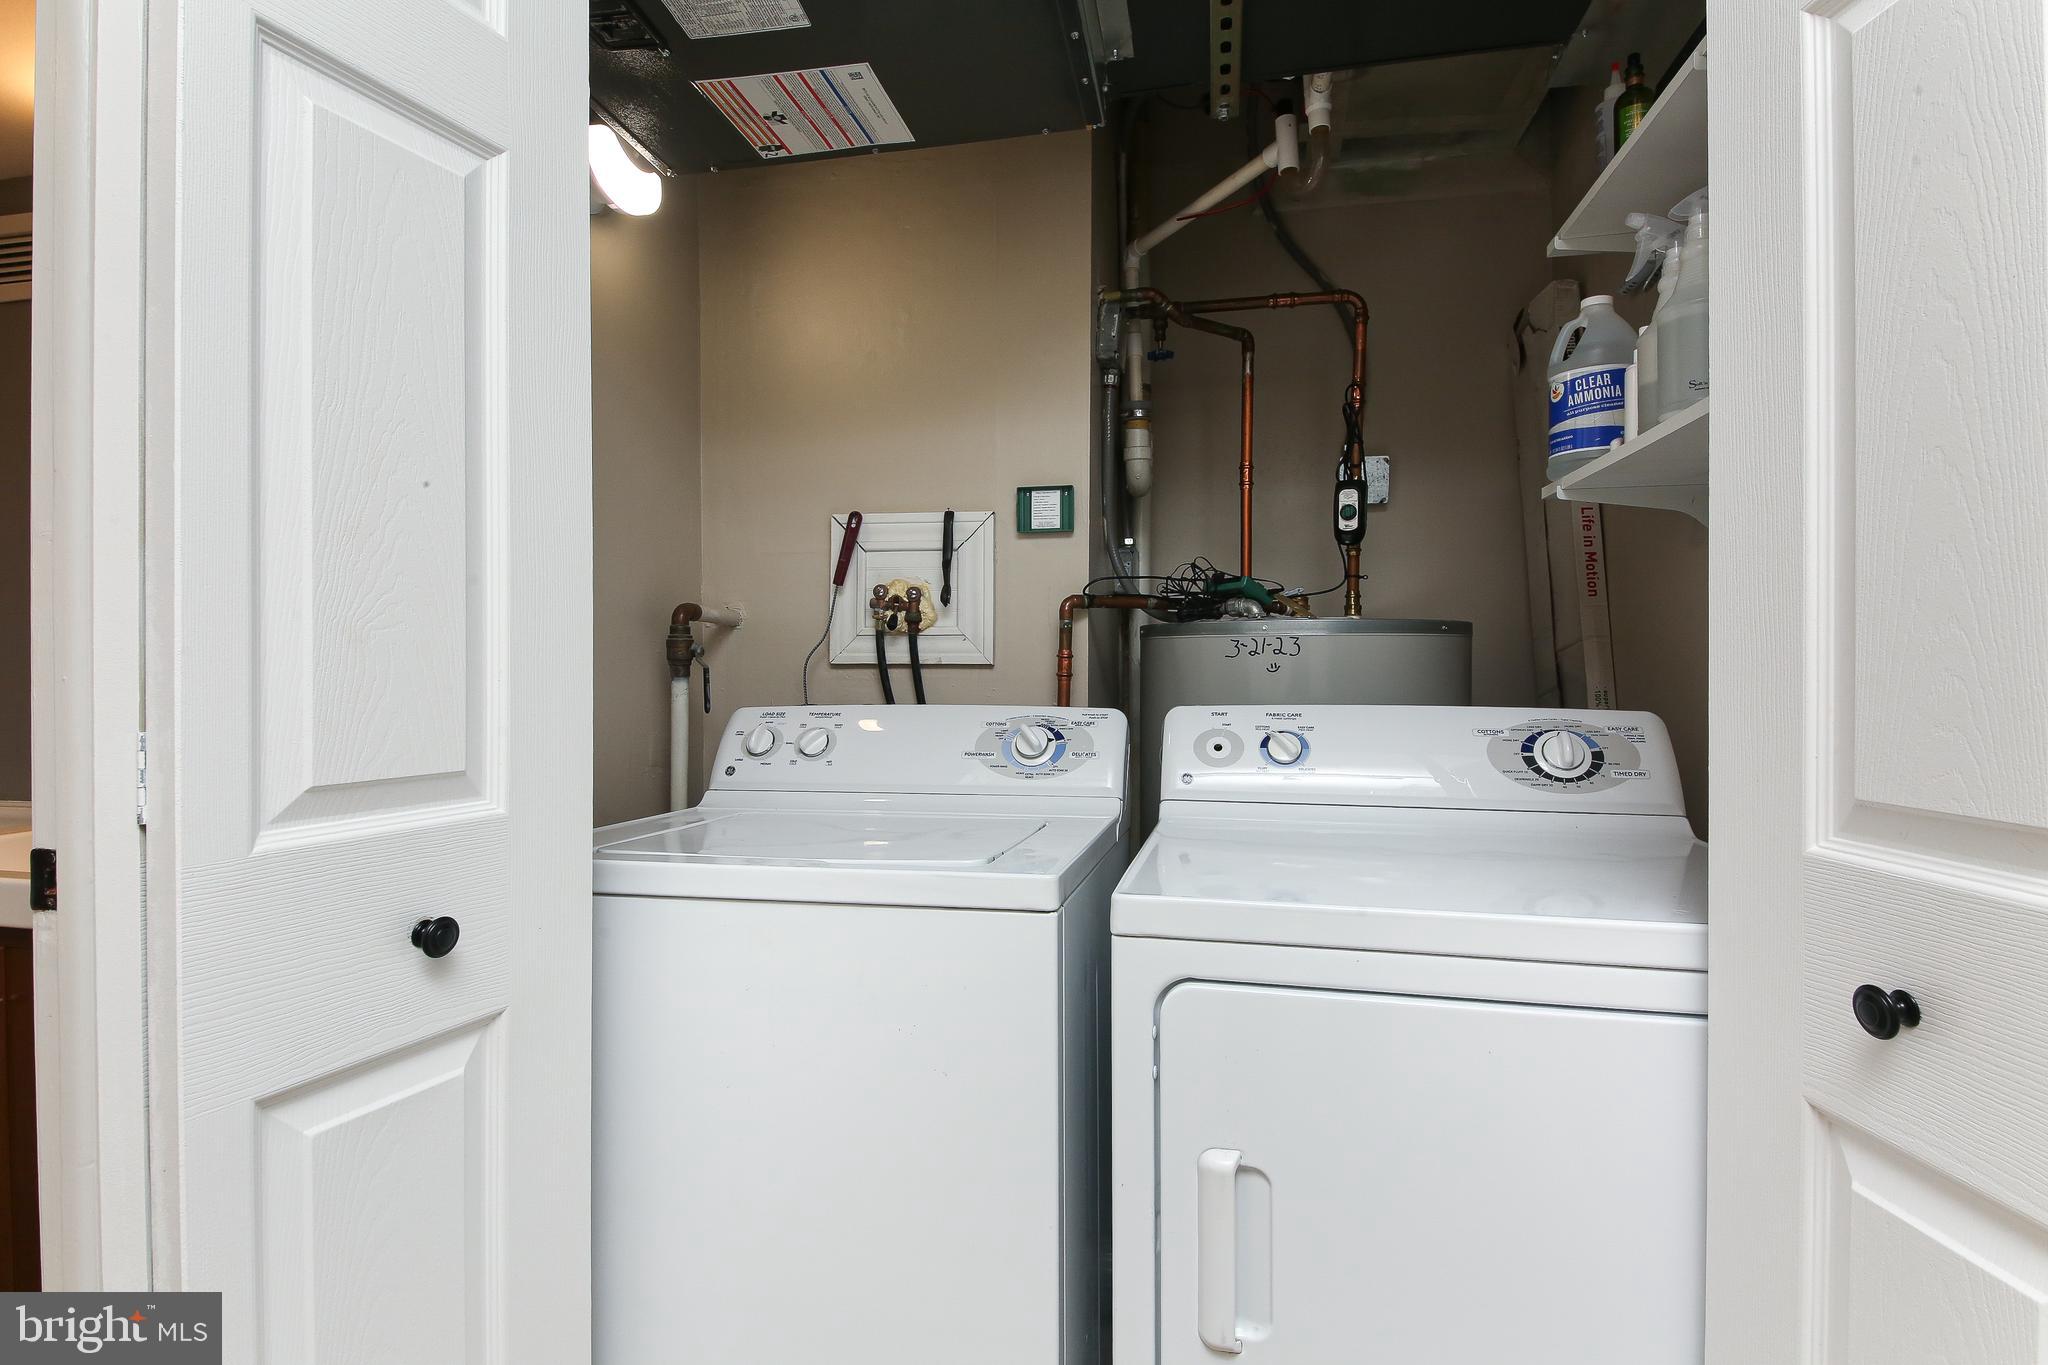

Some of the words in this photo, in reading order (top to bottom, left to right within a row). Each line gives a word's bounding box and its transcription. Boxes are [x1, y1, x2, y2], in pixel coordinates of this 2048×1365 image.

[1575, 373, 1611, 391] CLEAR
[1568, 384, 1622, 407] AMMONIA
[1574, 404, 1600, 415] purpose
[1581, 506, 1595, 532] Life
[1583, 535, 1596, 547] in
[1584, 551, 1600, 597] Motion
[1225, 636, 1301, 658] 3-21-23
